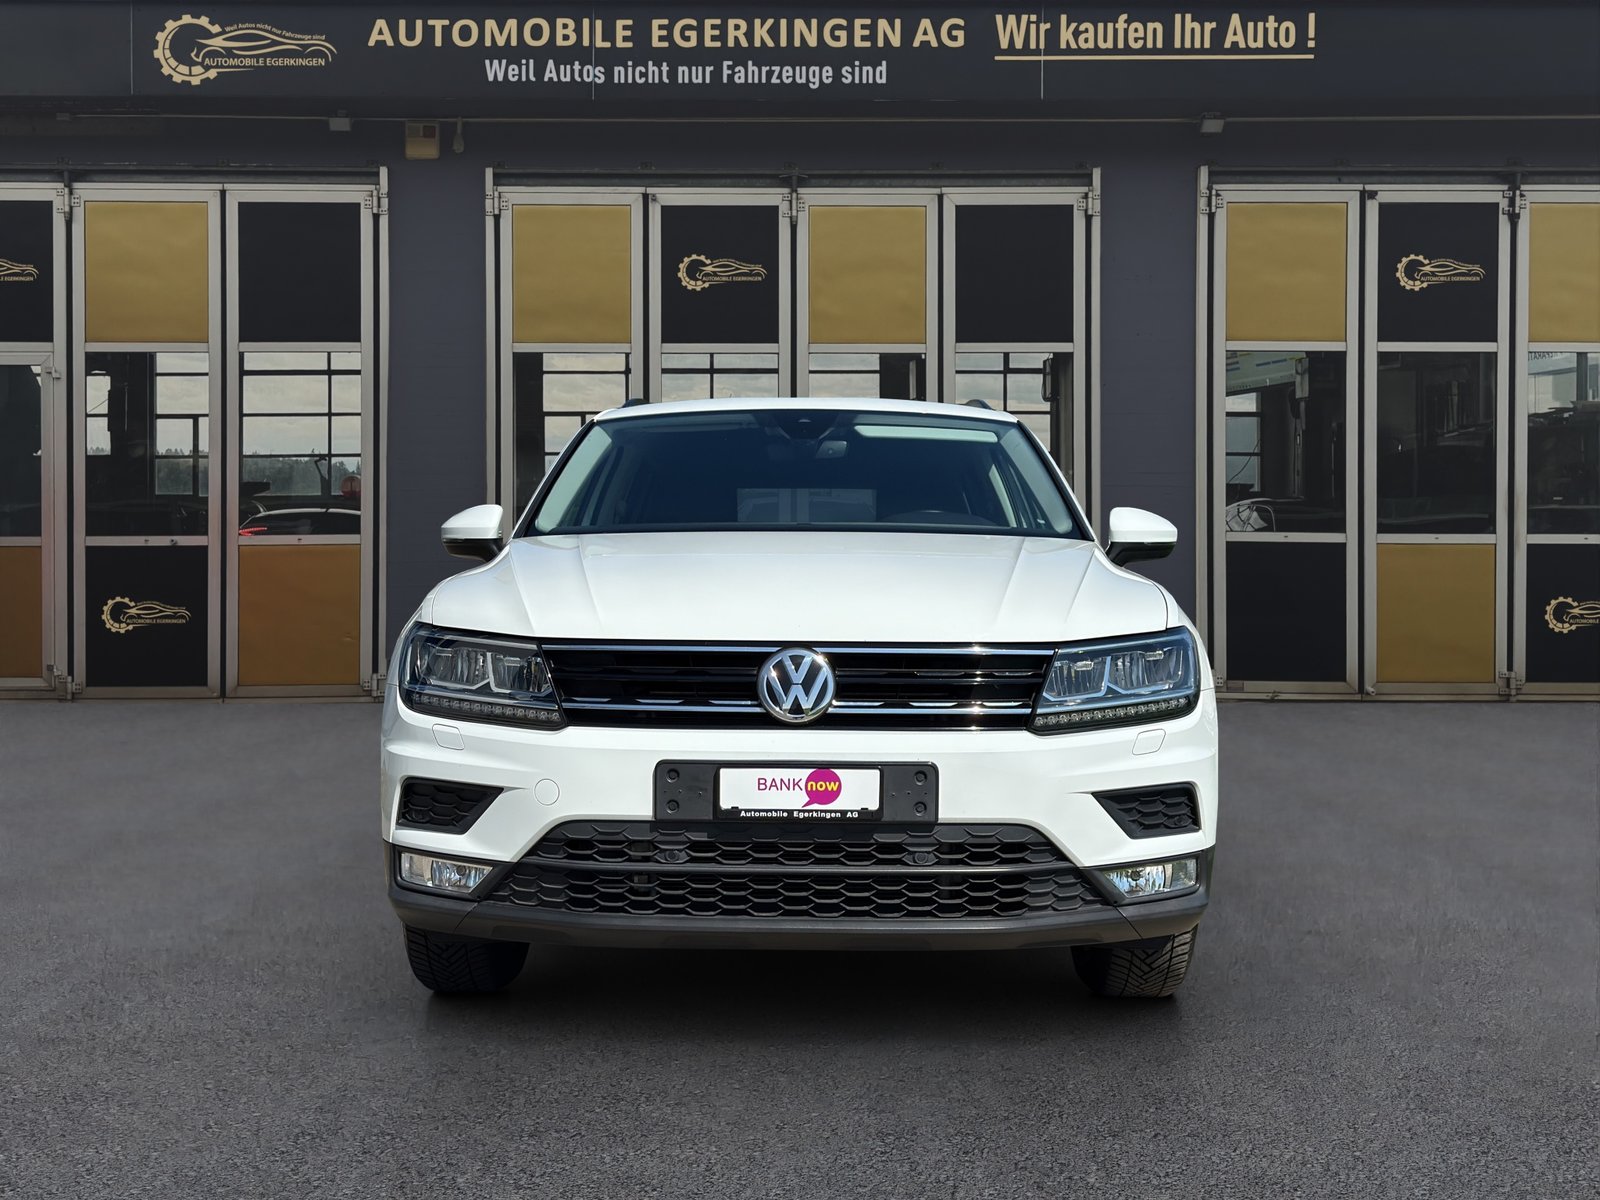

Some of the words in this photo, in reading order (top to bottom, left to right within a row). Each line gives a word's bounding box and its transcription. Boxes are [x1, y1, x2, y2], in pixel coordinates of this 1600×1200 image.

[225, 24, 237, 32] Weil
[271, 27, 282, 35] nur
[282, 30, 312, 40] Fahrzeuge
[367, 17, 634, 48] AUTOMOBILE
[651, 17, 902, 48] EGERKINGEN
[912, 17, 965, 48] AG
[995, 13, 1051, 50] Wir
[1059, 13, 1164, 49] kaufen
[1173, 13, 1217, 49] Ihr
[1223, 13, 1297, 49] Auto
[203, 57, 265, 67] AUTOMOBILE
[266, 57, 326, 67] EGERKINGEN
[484, 58, 536, 82] Weil
[543, 59, 606, 84] Autos
[613, 60, 670, 84] nicht
[677, 65, 714, 84] nur
[722, 60, 833, 90] Fahrzeuge
[841, 60, 887, 84] sind
[764, 652, 829, 717] VW
[757, 777, 803, 792] BANK
[807, 781, 840, 792] now
[740, 810, 788, 818] Automobile
[793, 811, 841, 819] Egerkingen
